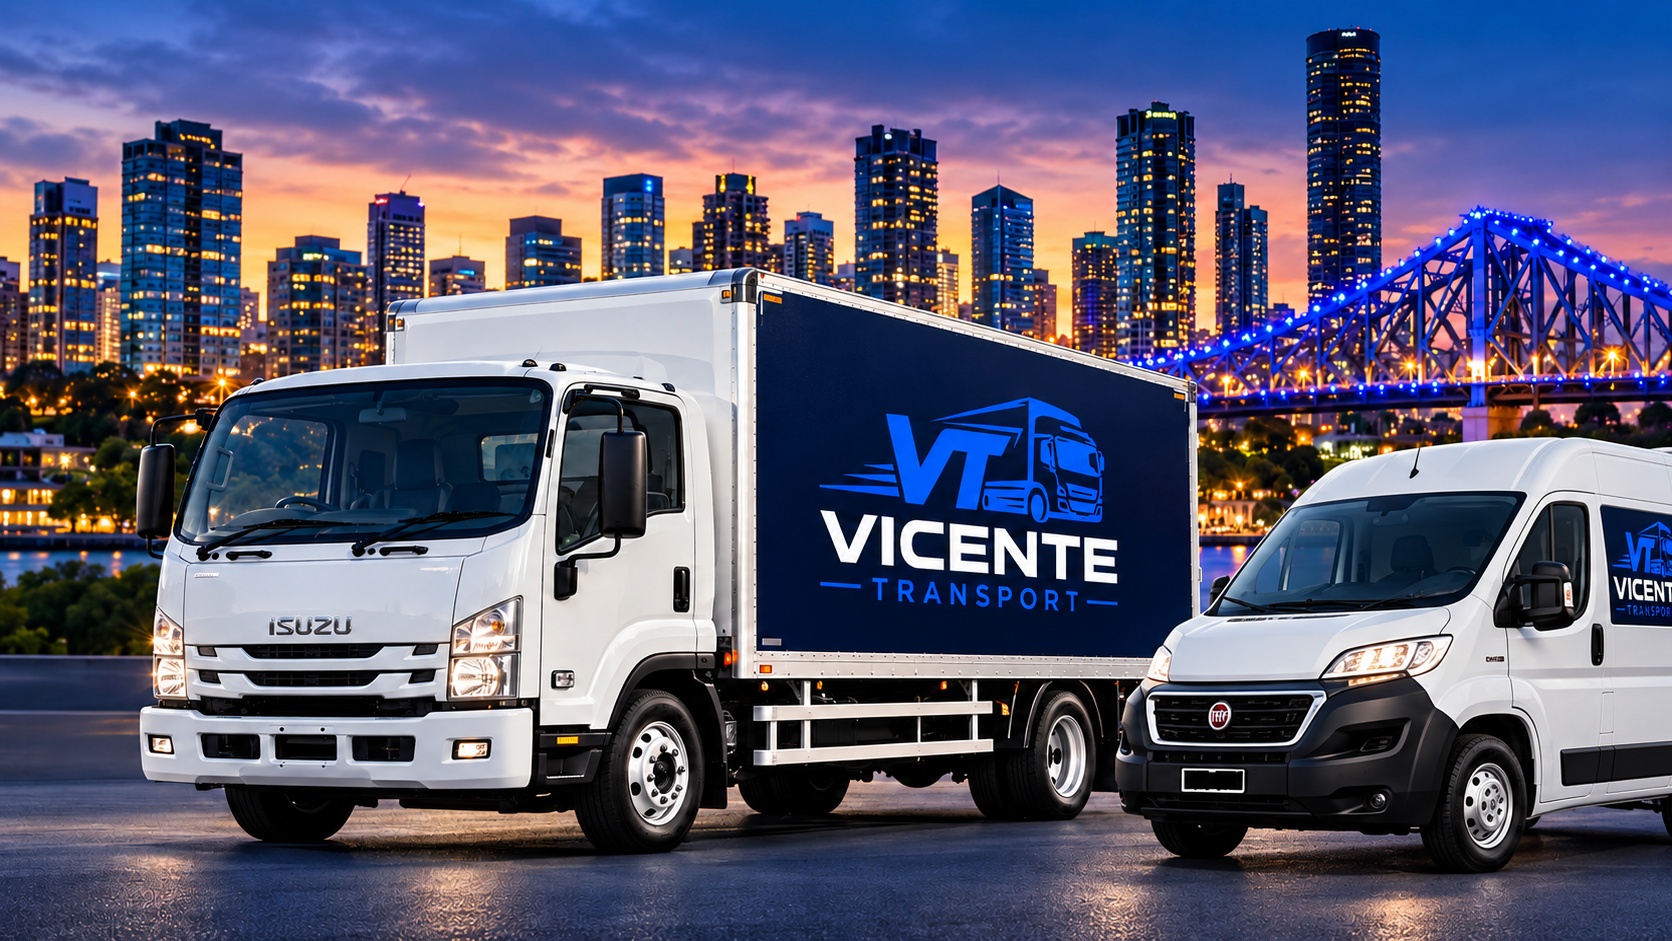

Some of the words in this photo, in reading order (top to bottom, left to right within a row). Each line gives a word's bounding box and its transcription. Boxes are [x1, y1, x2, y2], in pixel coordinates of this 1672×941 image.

[886, 413, 1011, 510] VT
[820, 509, 1118, 584] VICENTE
[1625, 531, 1656, 573] VT
[872, 577, 1079, 612] TRANSPORT
[269, 616, 352, 636] ISUZU
